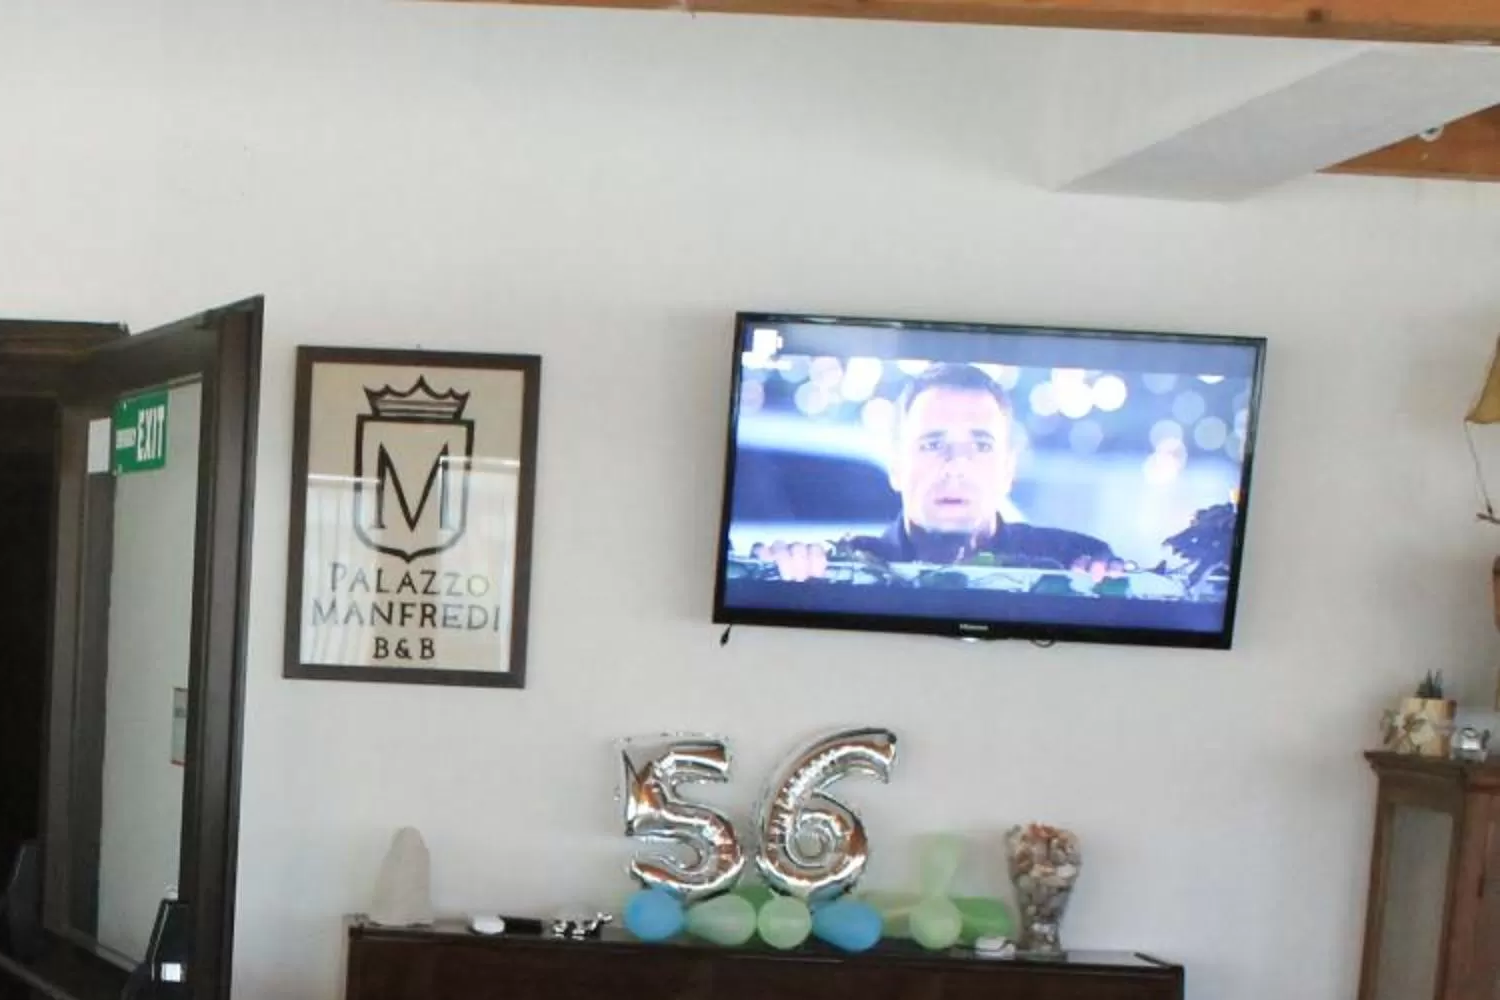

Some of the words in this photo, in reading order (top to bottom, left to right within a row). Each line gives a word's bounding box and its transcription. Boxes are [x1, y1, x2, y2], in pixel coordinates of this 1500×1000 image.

[137, 404, 165, 462] EXIT
[329, 561, 490, 598] PALAZZO
[311, 597, 501, 633] MANFREDI
